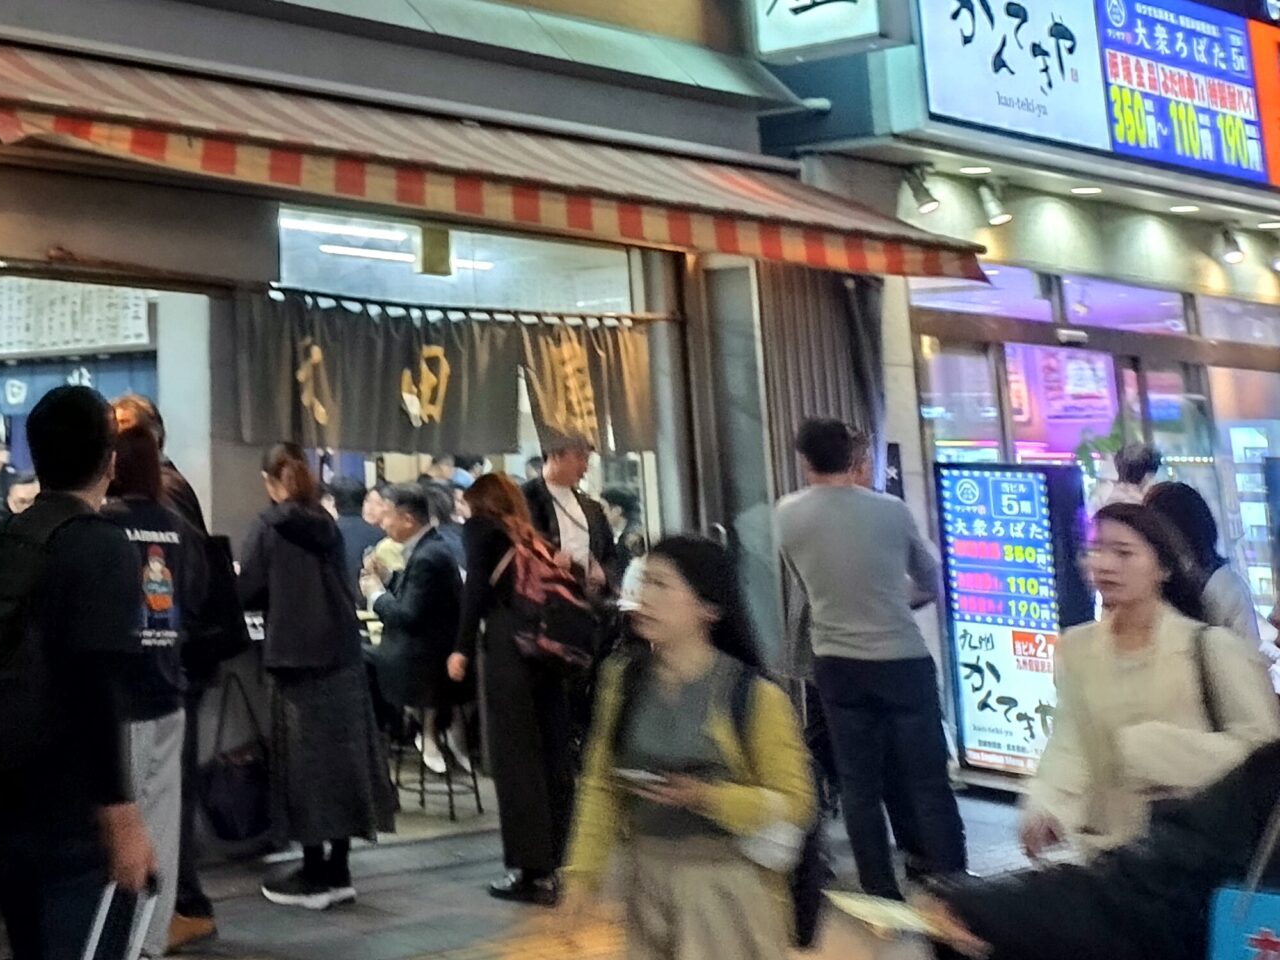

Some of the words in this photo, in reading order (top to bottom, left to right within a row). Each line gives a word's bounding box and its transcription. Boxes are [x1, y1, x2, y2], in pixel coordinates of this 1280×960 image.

[1134, 17, 1228, 71] 大衆ろばた
